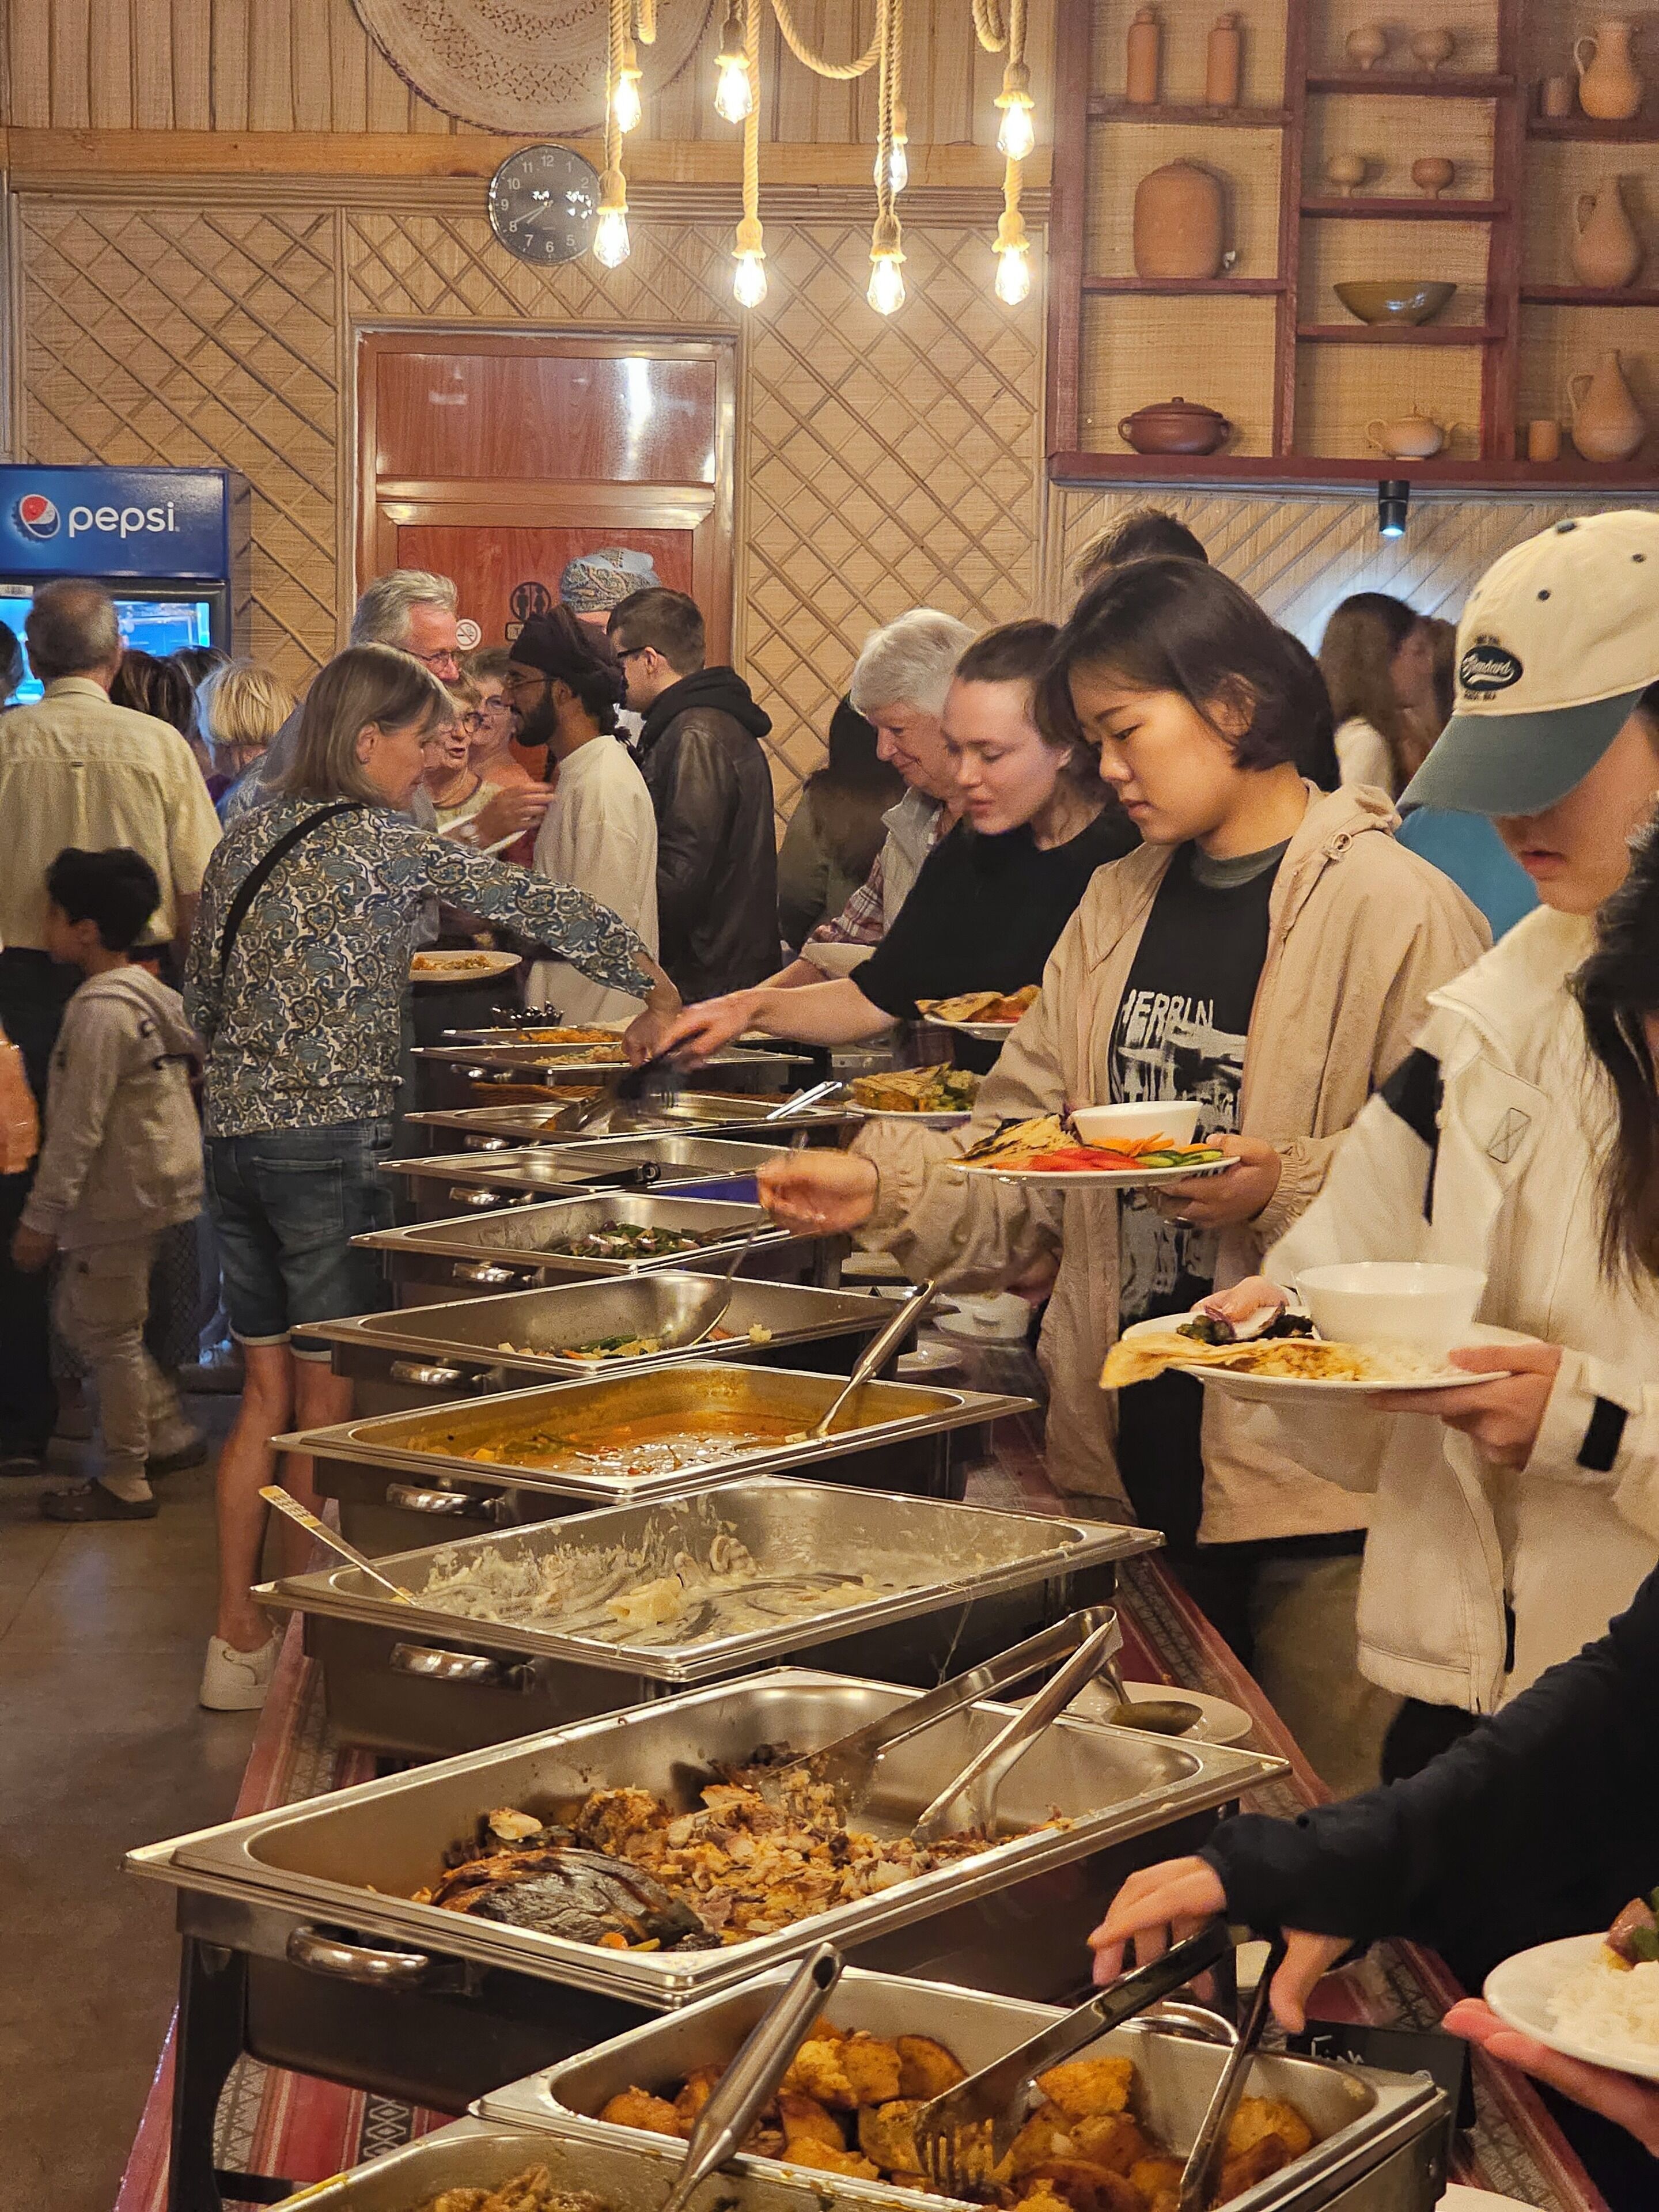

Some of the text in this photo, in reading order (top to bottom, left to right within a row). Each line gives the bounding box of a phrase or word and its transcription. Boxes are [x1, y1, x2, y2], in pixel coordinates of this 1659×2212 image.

[541, 155, 554, 167] 12
[522, 162, 533, 173] 11
[566, 162, 572, 172] 1
[507, 177, 521, 190] 10
[581, 177, 589, 188] 2
[501, 199, 509, 210] 9
[509, 221, 517, 232] 8
[525, 234, 533, 247] 7
[566, 235, 575, 247] 5
[546, 241, 554, 252] 6
[69, 501, 174, 539] pepsi
